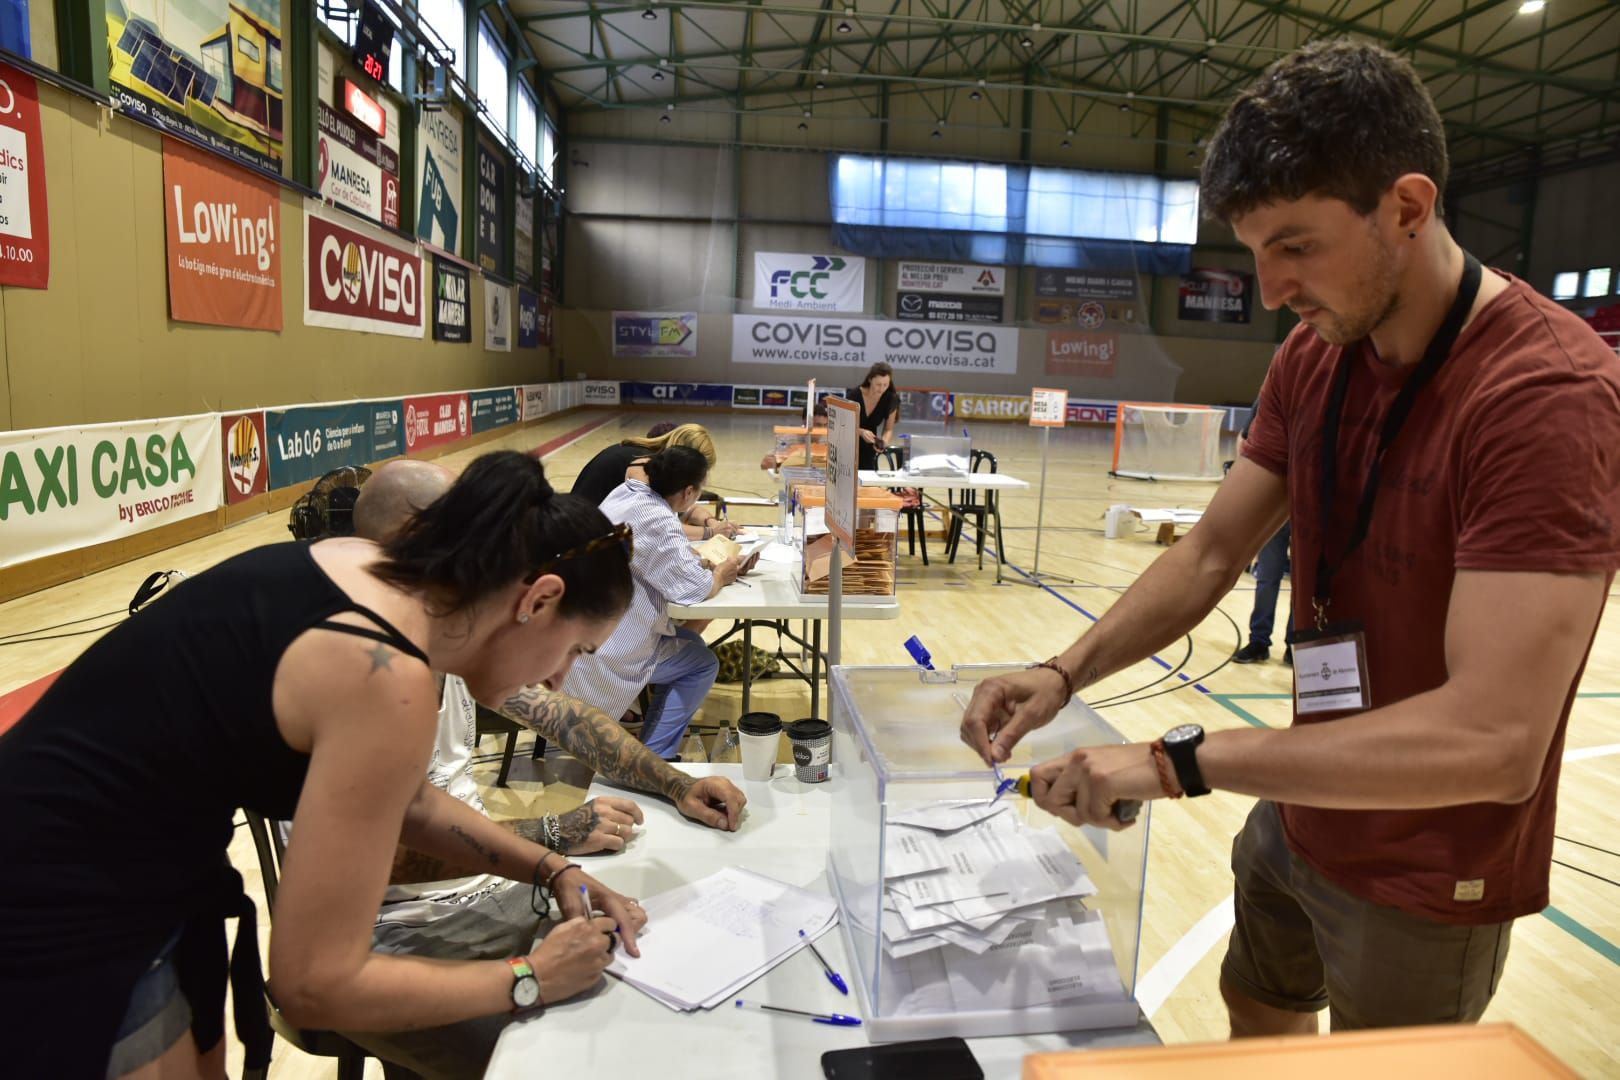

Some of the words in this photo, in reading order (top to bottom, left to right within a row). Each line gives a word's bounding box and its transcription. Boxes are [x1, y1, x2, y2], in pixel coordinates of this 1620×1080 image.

[331, 160, 371, 198] MANRESA
[425, 161, 442, 212] FUB
[174, 185, 275, 271] Lowing!
[770, 270, 830, 300] FCC
[769, 299, 792, 308] Medi
[797, 300, 837, 310] Ambient
[619, 326, 654, 337] STYL
[752, 347, 866, 363] www.covisa.cat
[885, 352, 996, 368] www.covisa.cat
[1051, 338, 1114, 361] Lowing!
[277, 430, 302, 461] Lab
[92, 431, 196, 499] CASA
[119, 503, 134, 523] by
